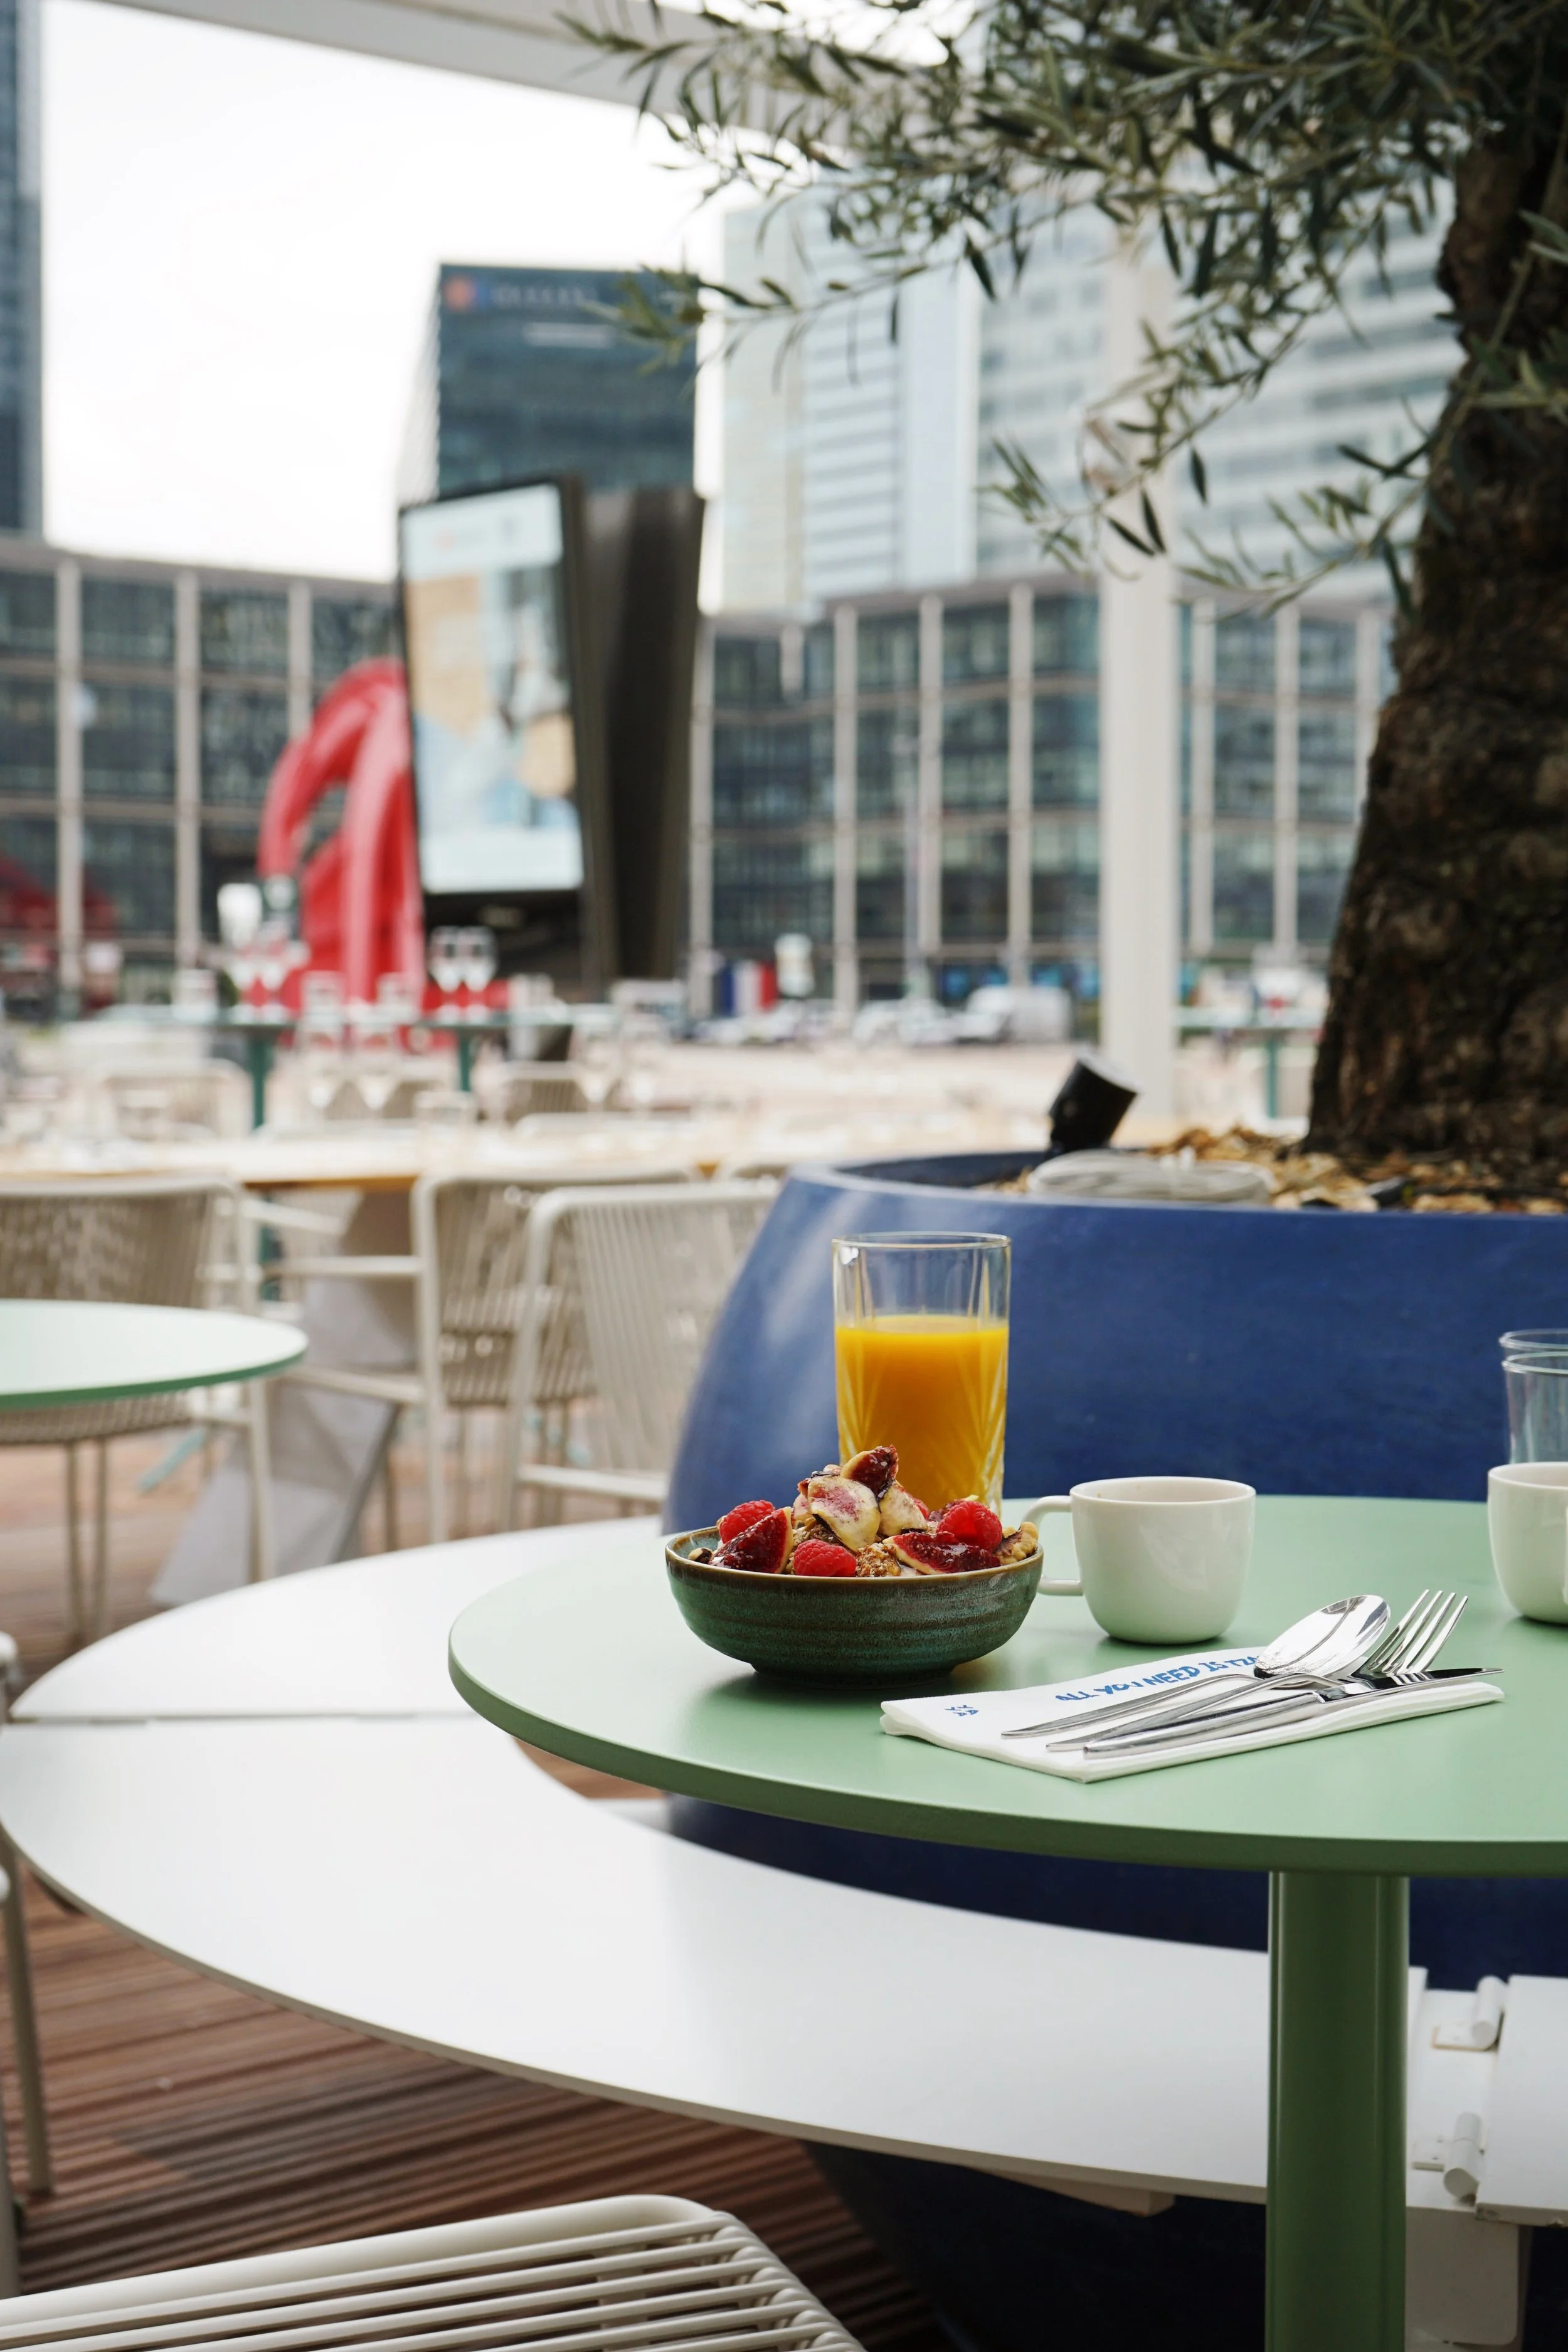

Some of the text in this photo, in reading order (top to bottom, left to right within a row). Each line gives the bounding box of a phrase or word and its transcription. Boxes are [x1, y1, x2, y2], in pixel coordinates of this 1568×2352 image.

[1056, 1692, 1100, 1701] ALL
[1094, 1682, 1143, 1695] YOU
[1142, 1666, 1200, 1685] NEED
[1199, 1661, 1229, 1672] IS
